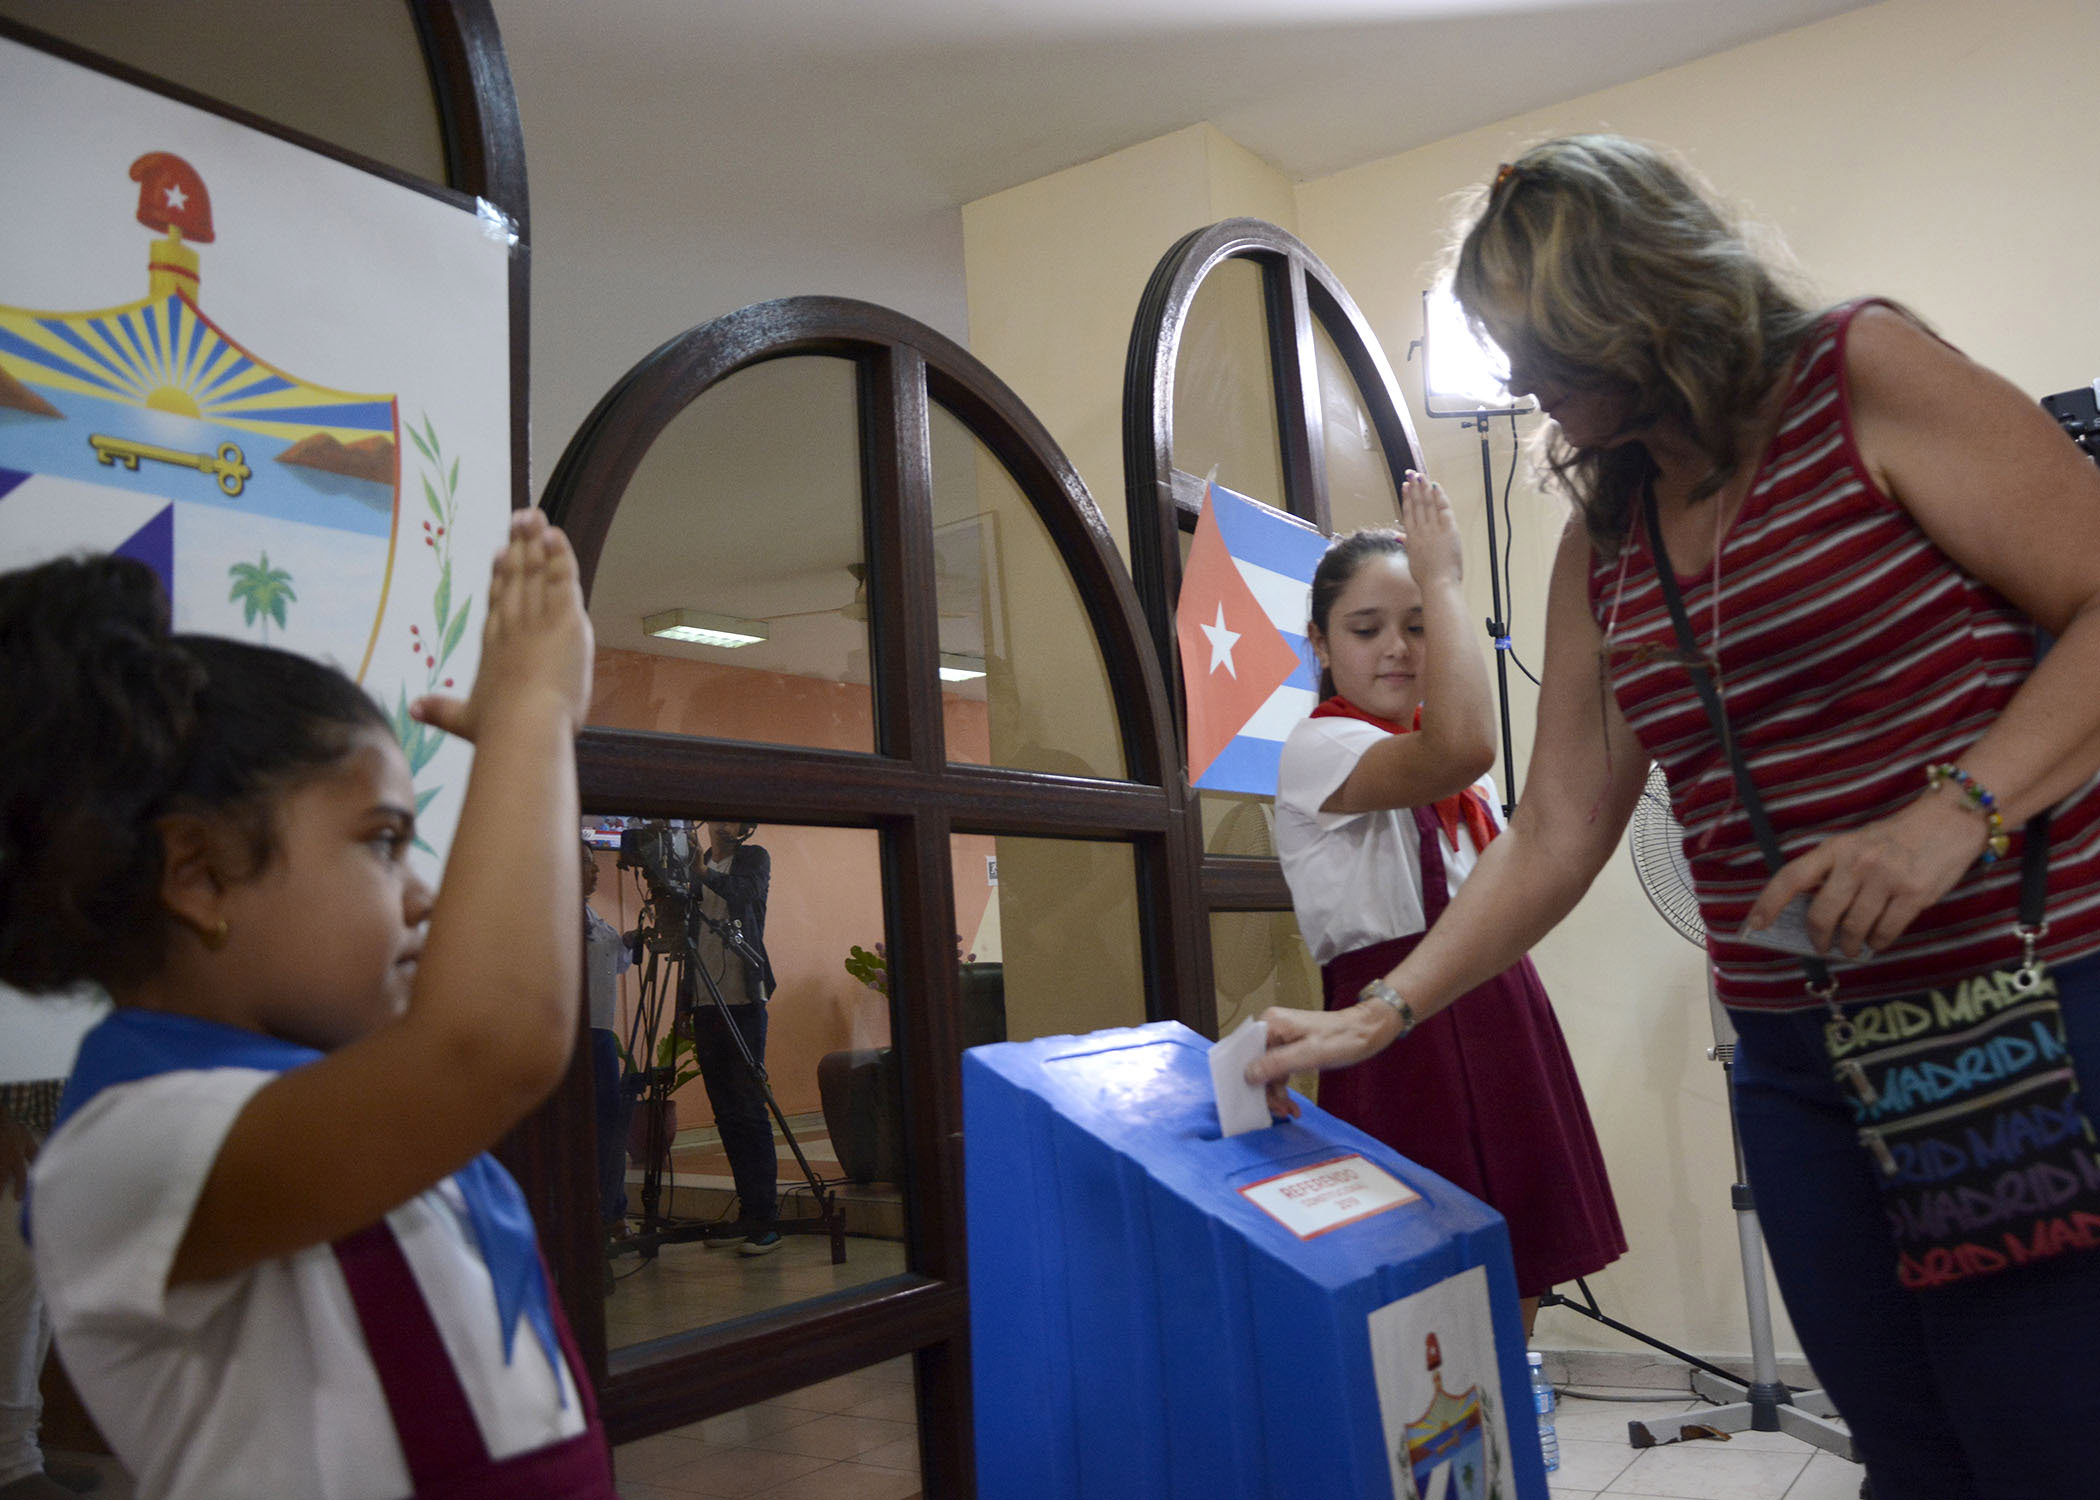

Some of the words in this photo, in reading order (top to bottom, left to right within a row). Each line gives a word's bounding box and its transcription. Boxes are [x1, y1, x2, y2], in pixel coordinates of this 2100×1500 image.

[1825, 1001, 1932, 1057] DRID
[1866, 1036, 2037, 1121] MADRID
[1897, 1161, 2080, 1241] MADRID
[1900, 1242, 2008, 1288] DRID
